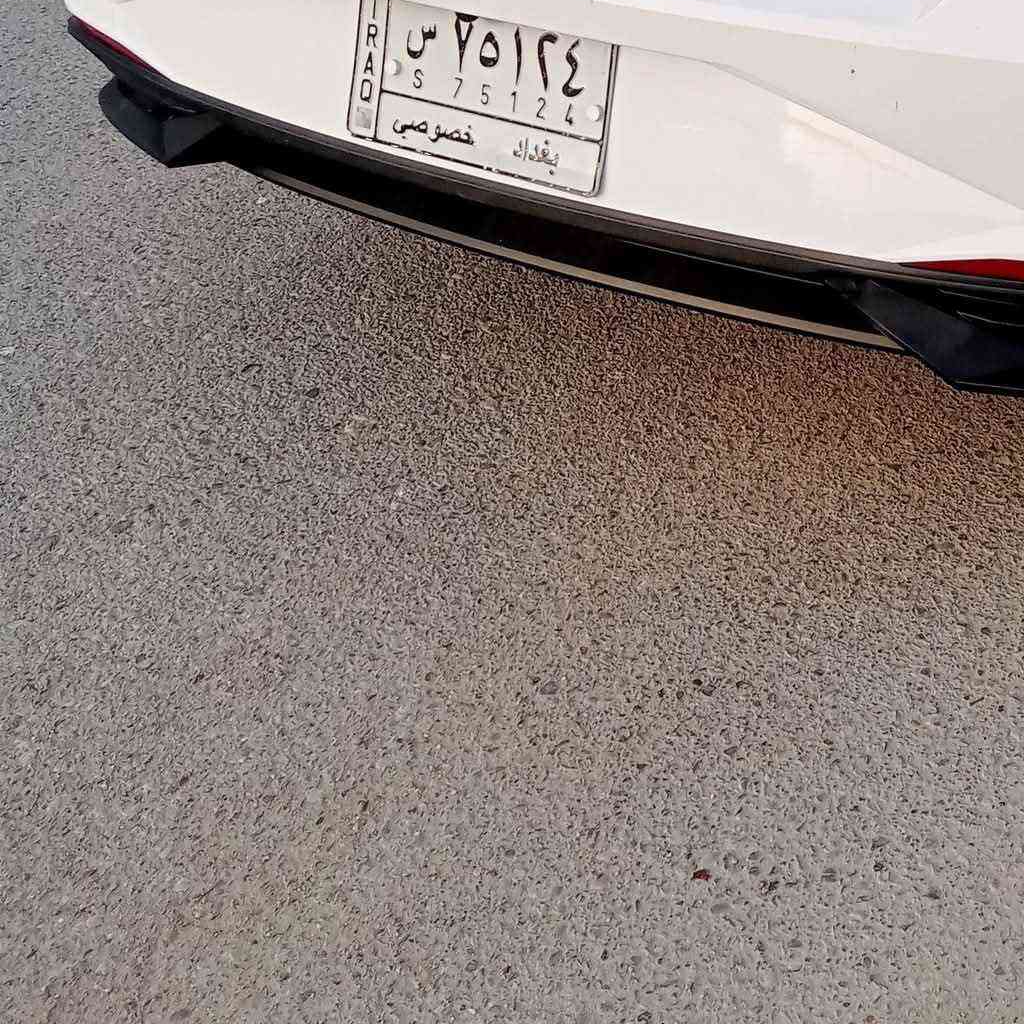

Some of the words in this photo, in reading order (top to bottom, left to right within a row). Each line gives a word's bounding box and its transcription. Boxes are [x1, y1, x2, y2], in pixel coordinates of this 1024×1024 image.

[412, 68, 425, 89] S
[452, 77, 575, 126] 75124
[392, 117, 476, 147] خصوصي
[512, 138, 560, 176] بغداد
